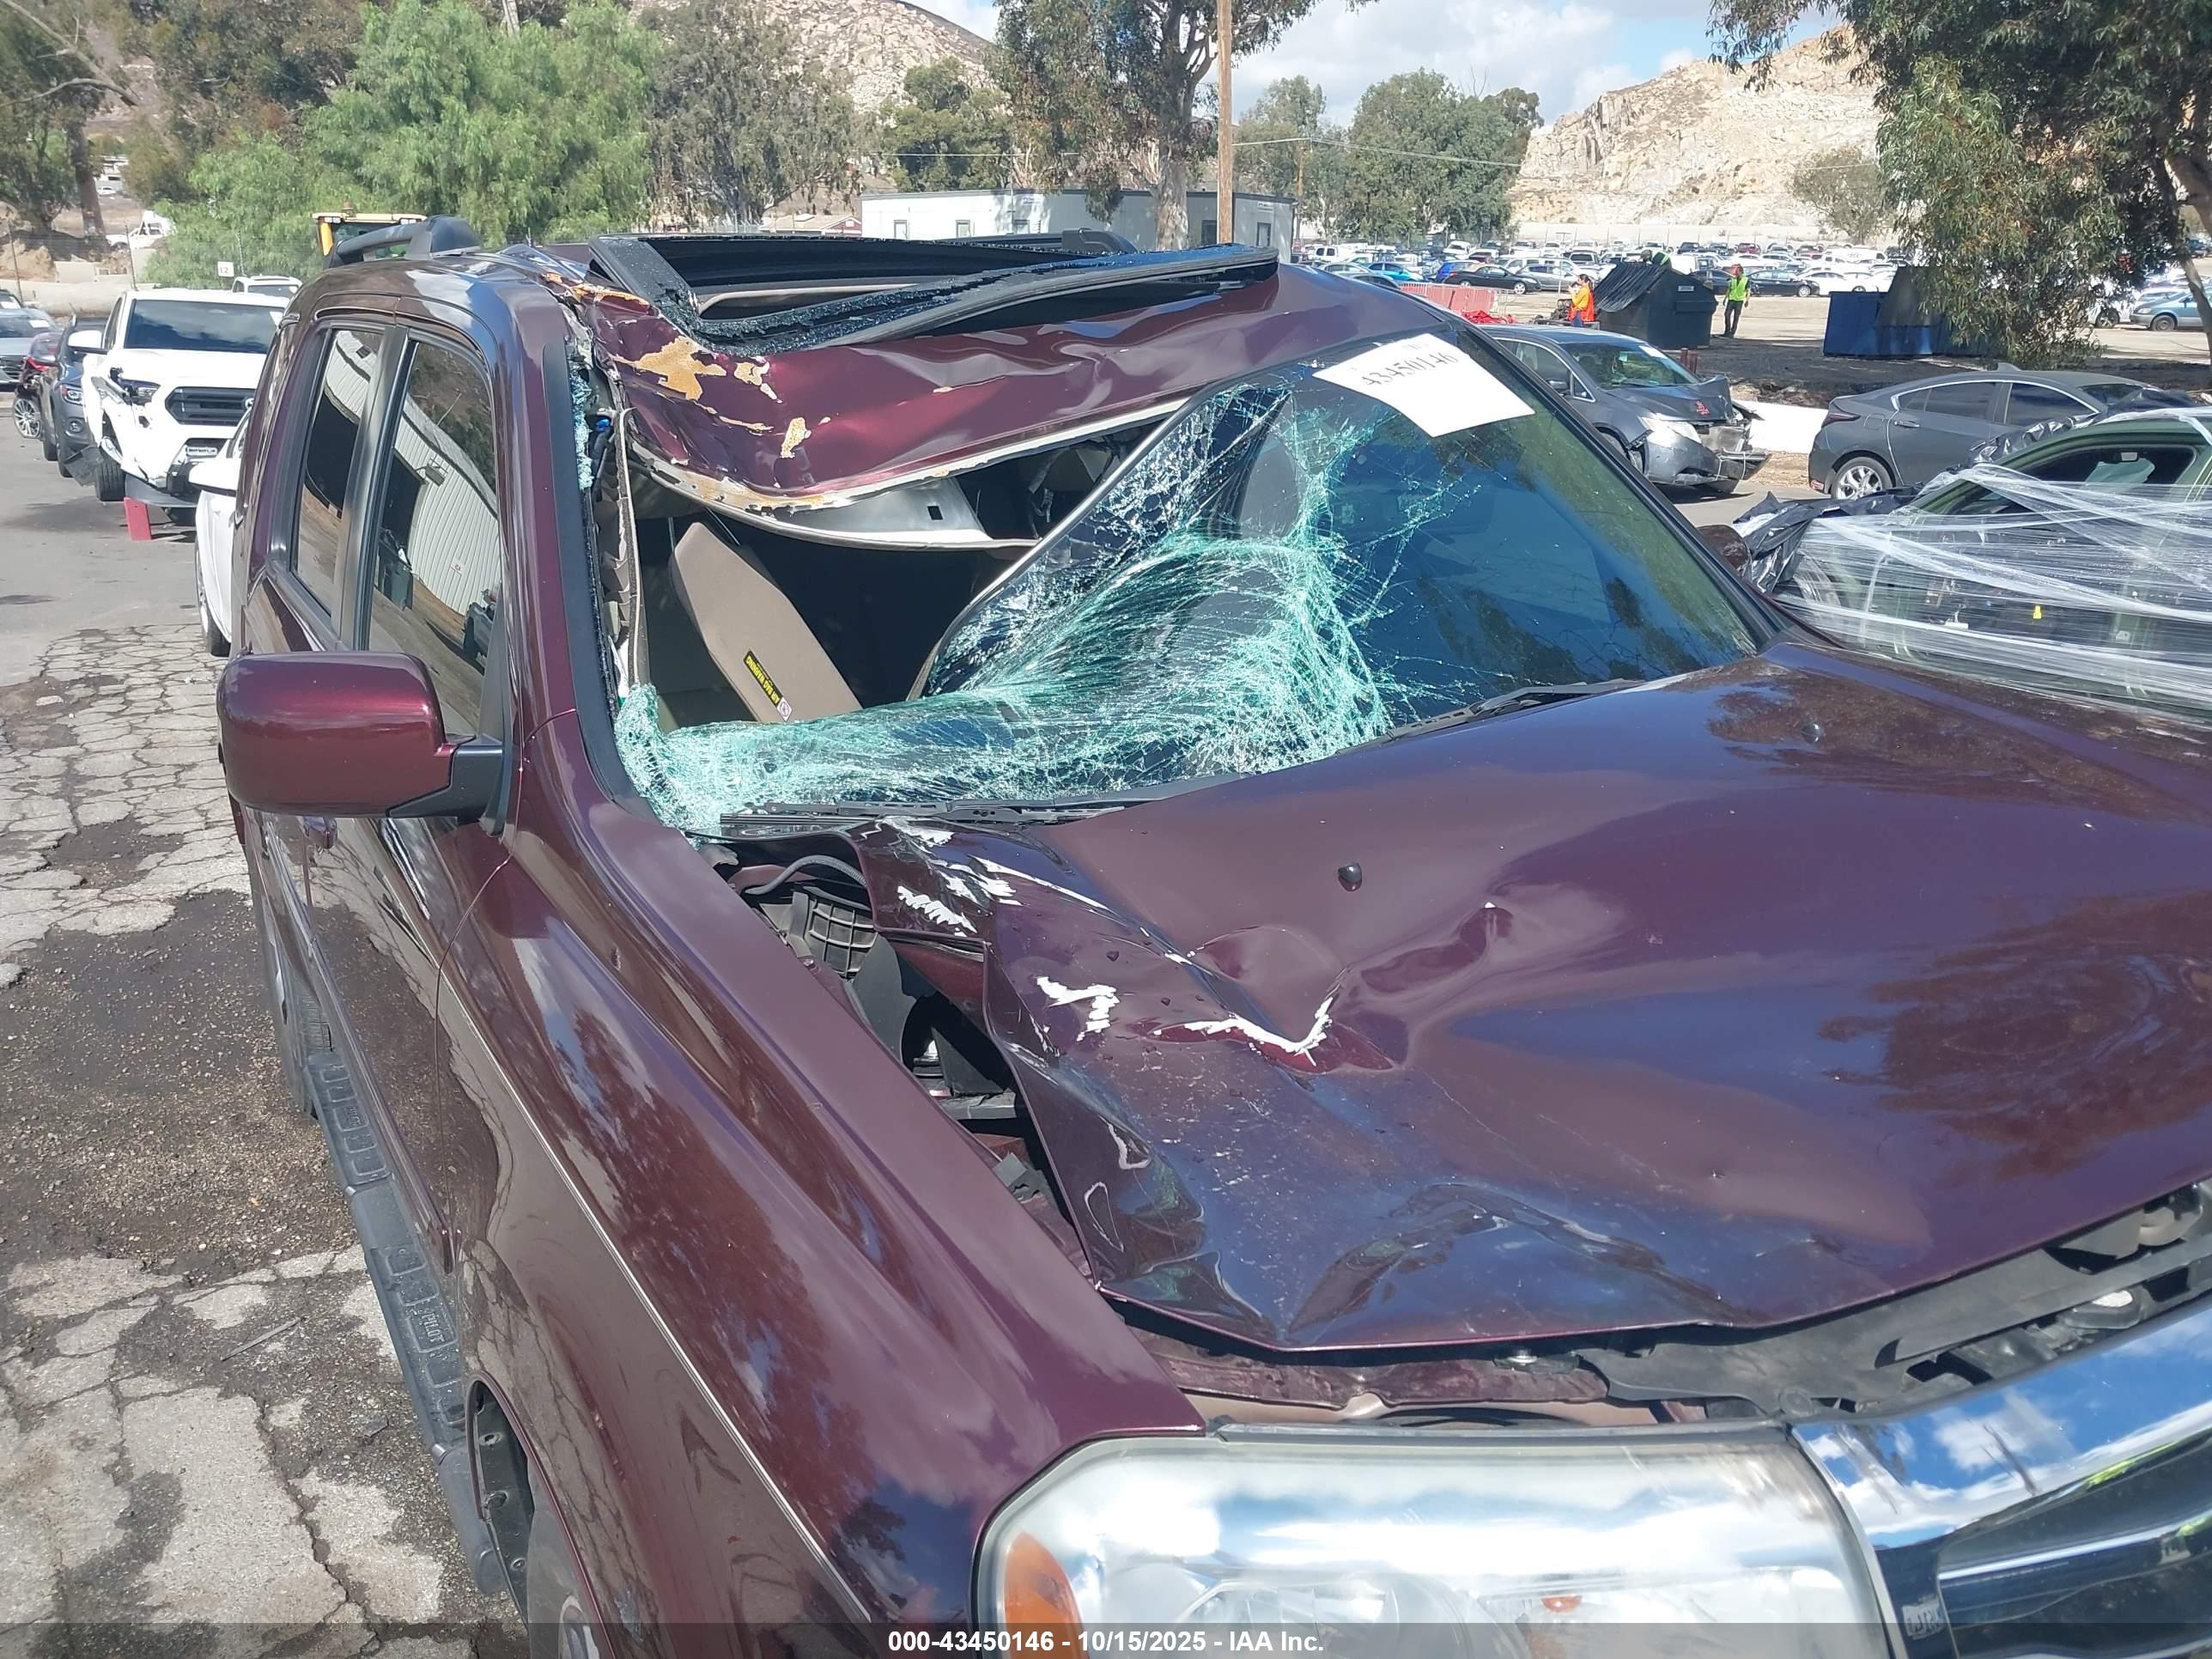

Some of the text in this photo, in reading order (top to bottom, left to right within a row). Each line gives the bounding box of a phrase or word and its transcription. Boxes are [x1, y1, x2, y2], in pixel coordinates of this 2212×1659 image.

[1360, 351, 1459, 386] 43450146
[746, 655, 765, 684] WARNING
[763, 678, 774, 696] BAG
[770, 690, 781, 704] AIR
[421, 1312, 447, 1346] PILOT
